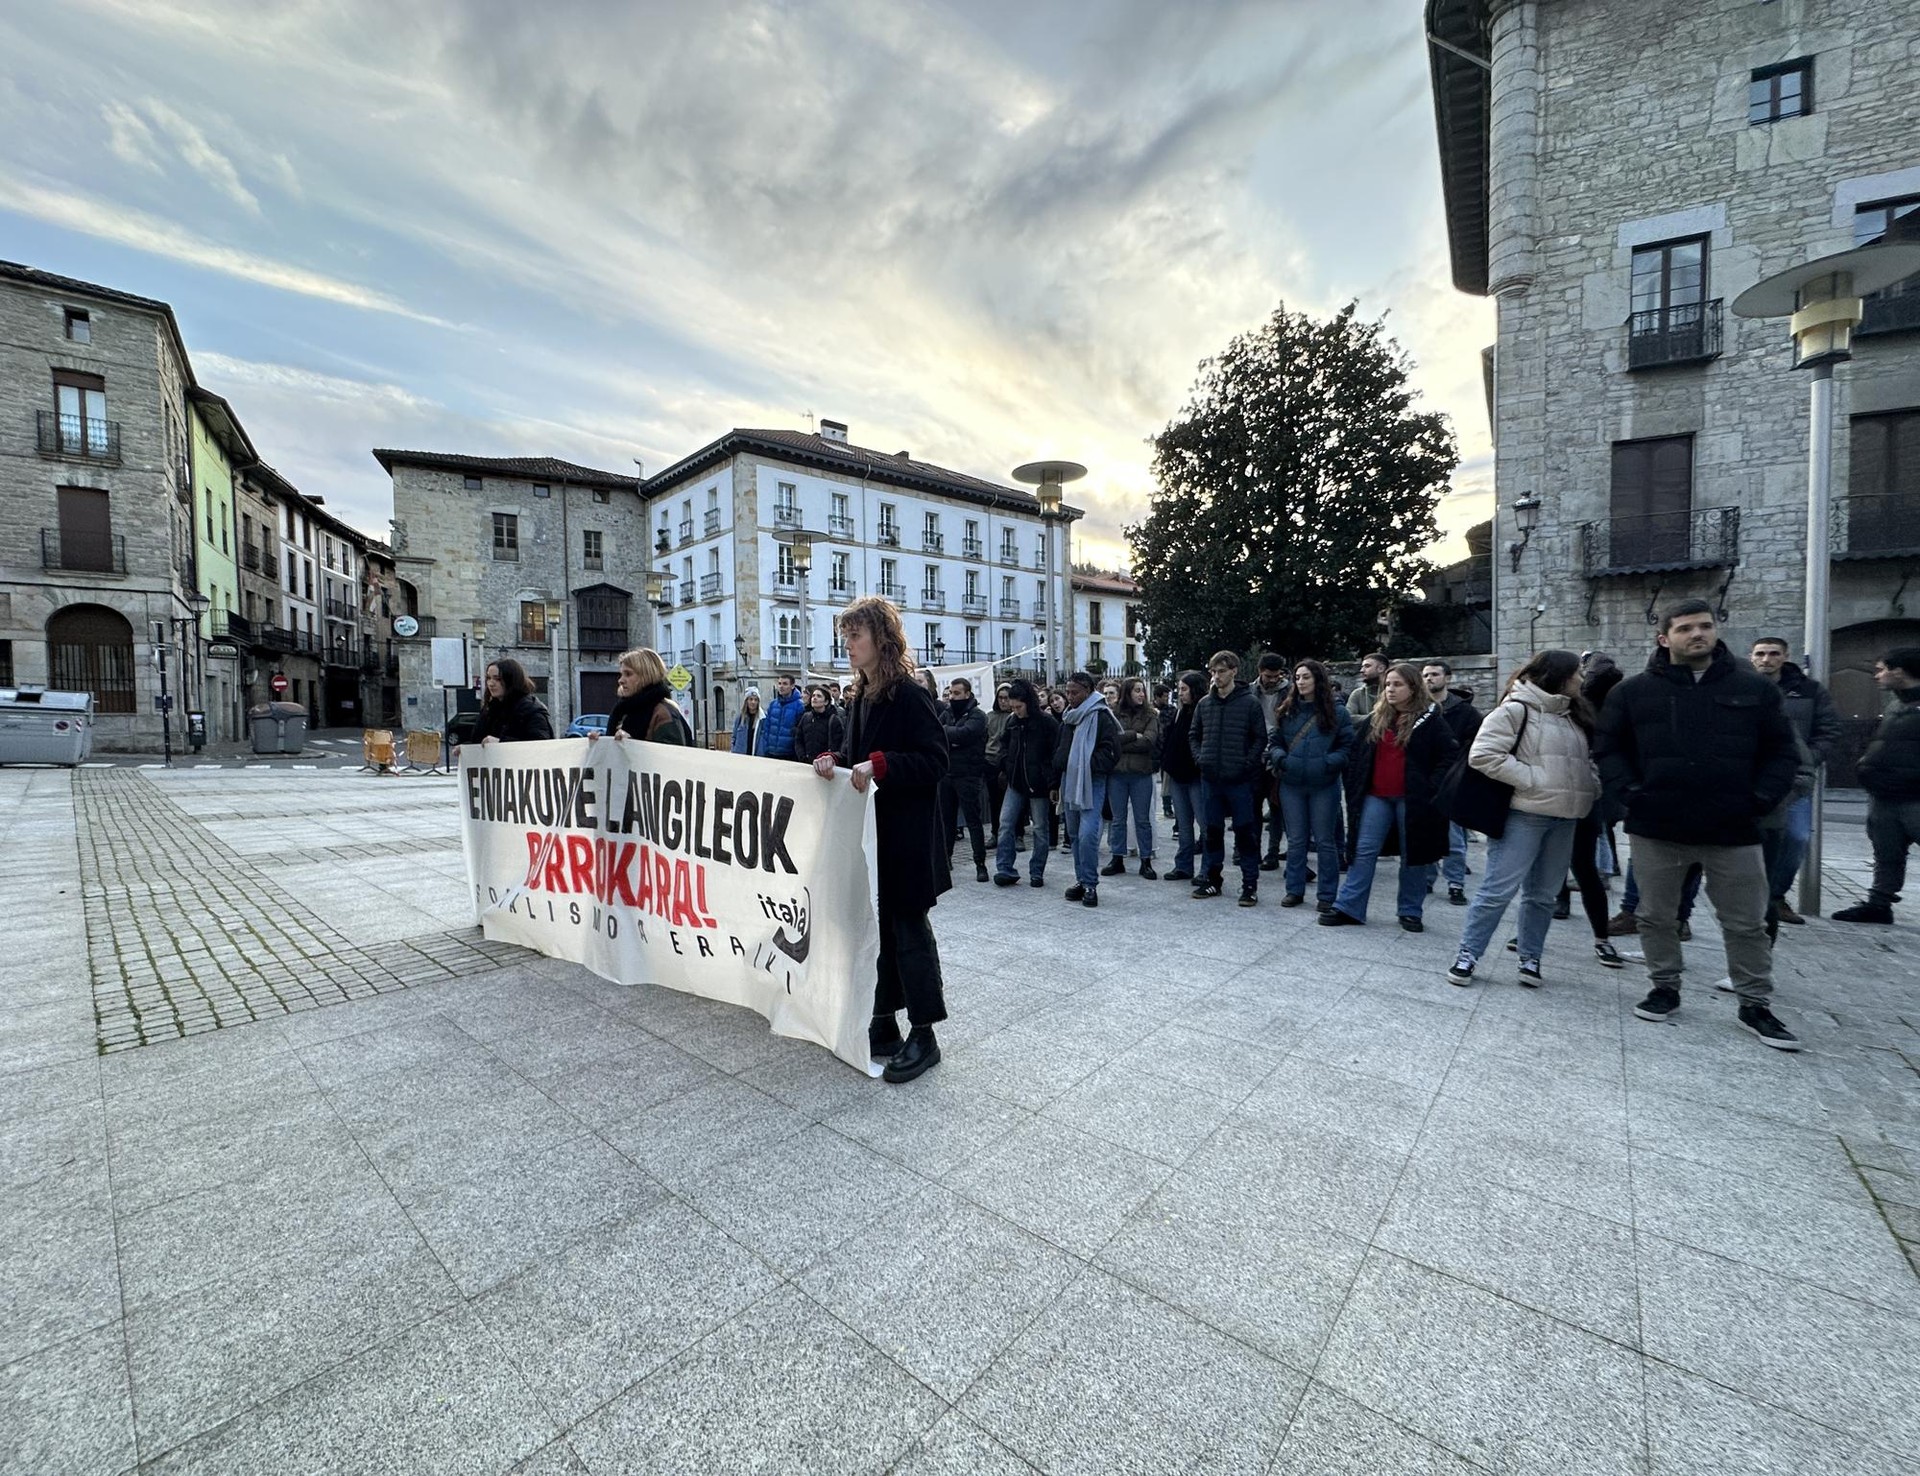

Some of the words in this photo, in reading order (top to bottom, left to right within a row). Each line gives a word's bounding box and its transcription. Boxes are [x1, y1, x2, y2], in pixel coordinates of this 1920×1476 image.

[467, 767, 597, 829] EMAKUME
[606, 768, 798, 875] LANGILEOK
[670, 931, 791, 995] ERAIKI
